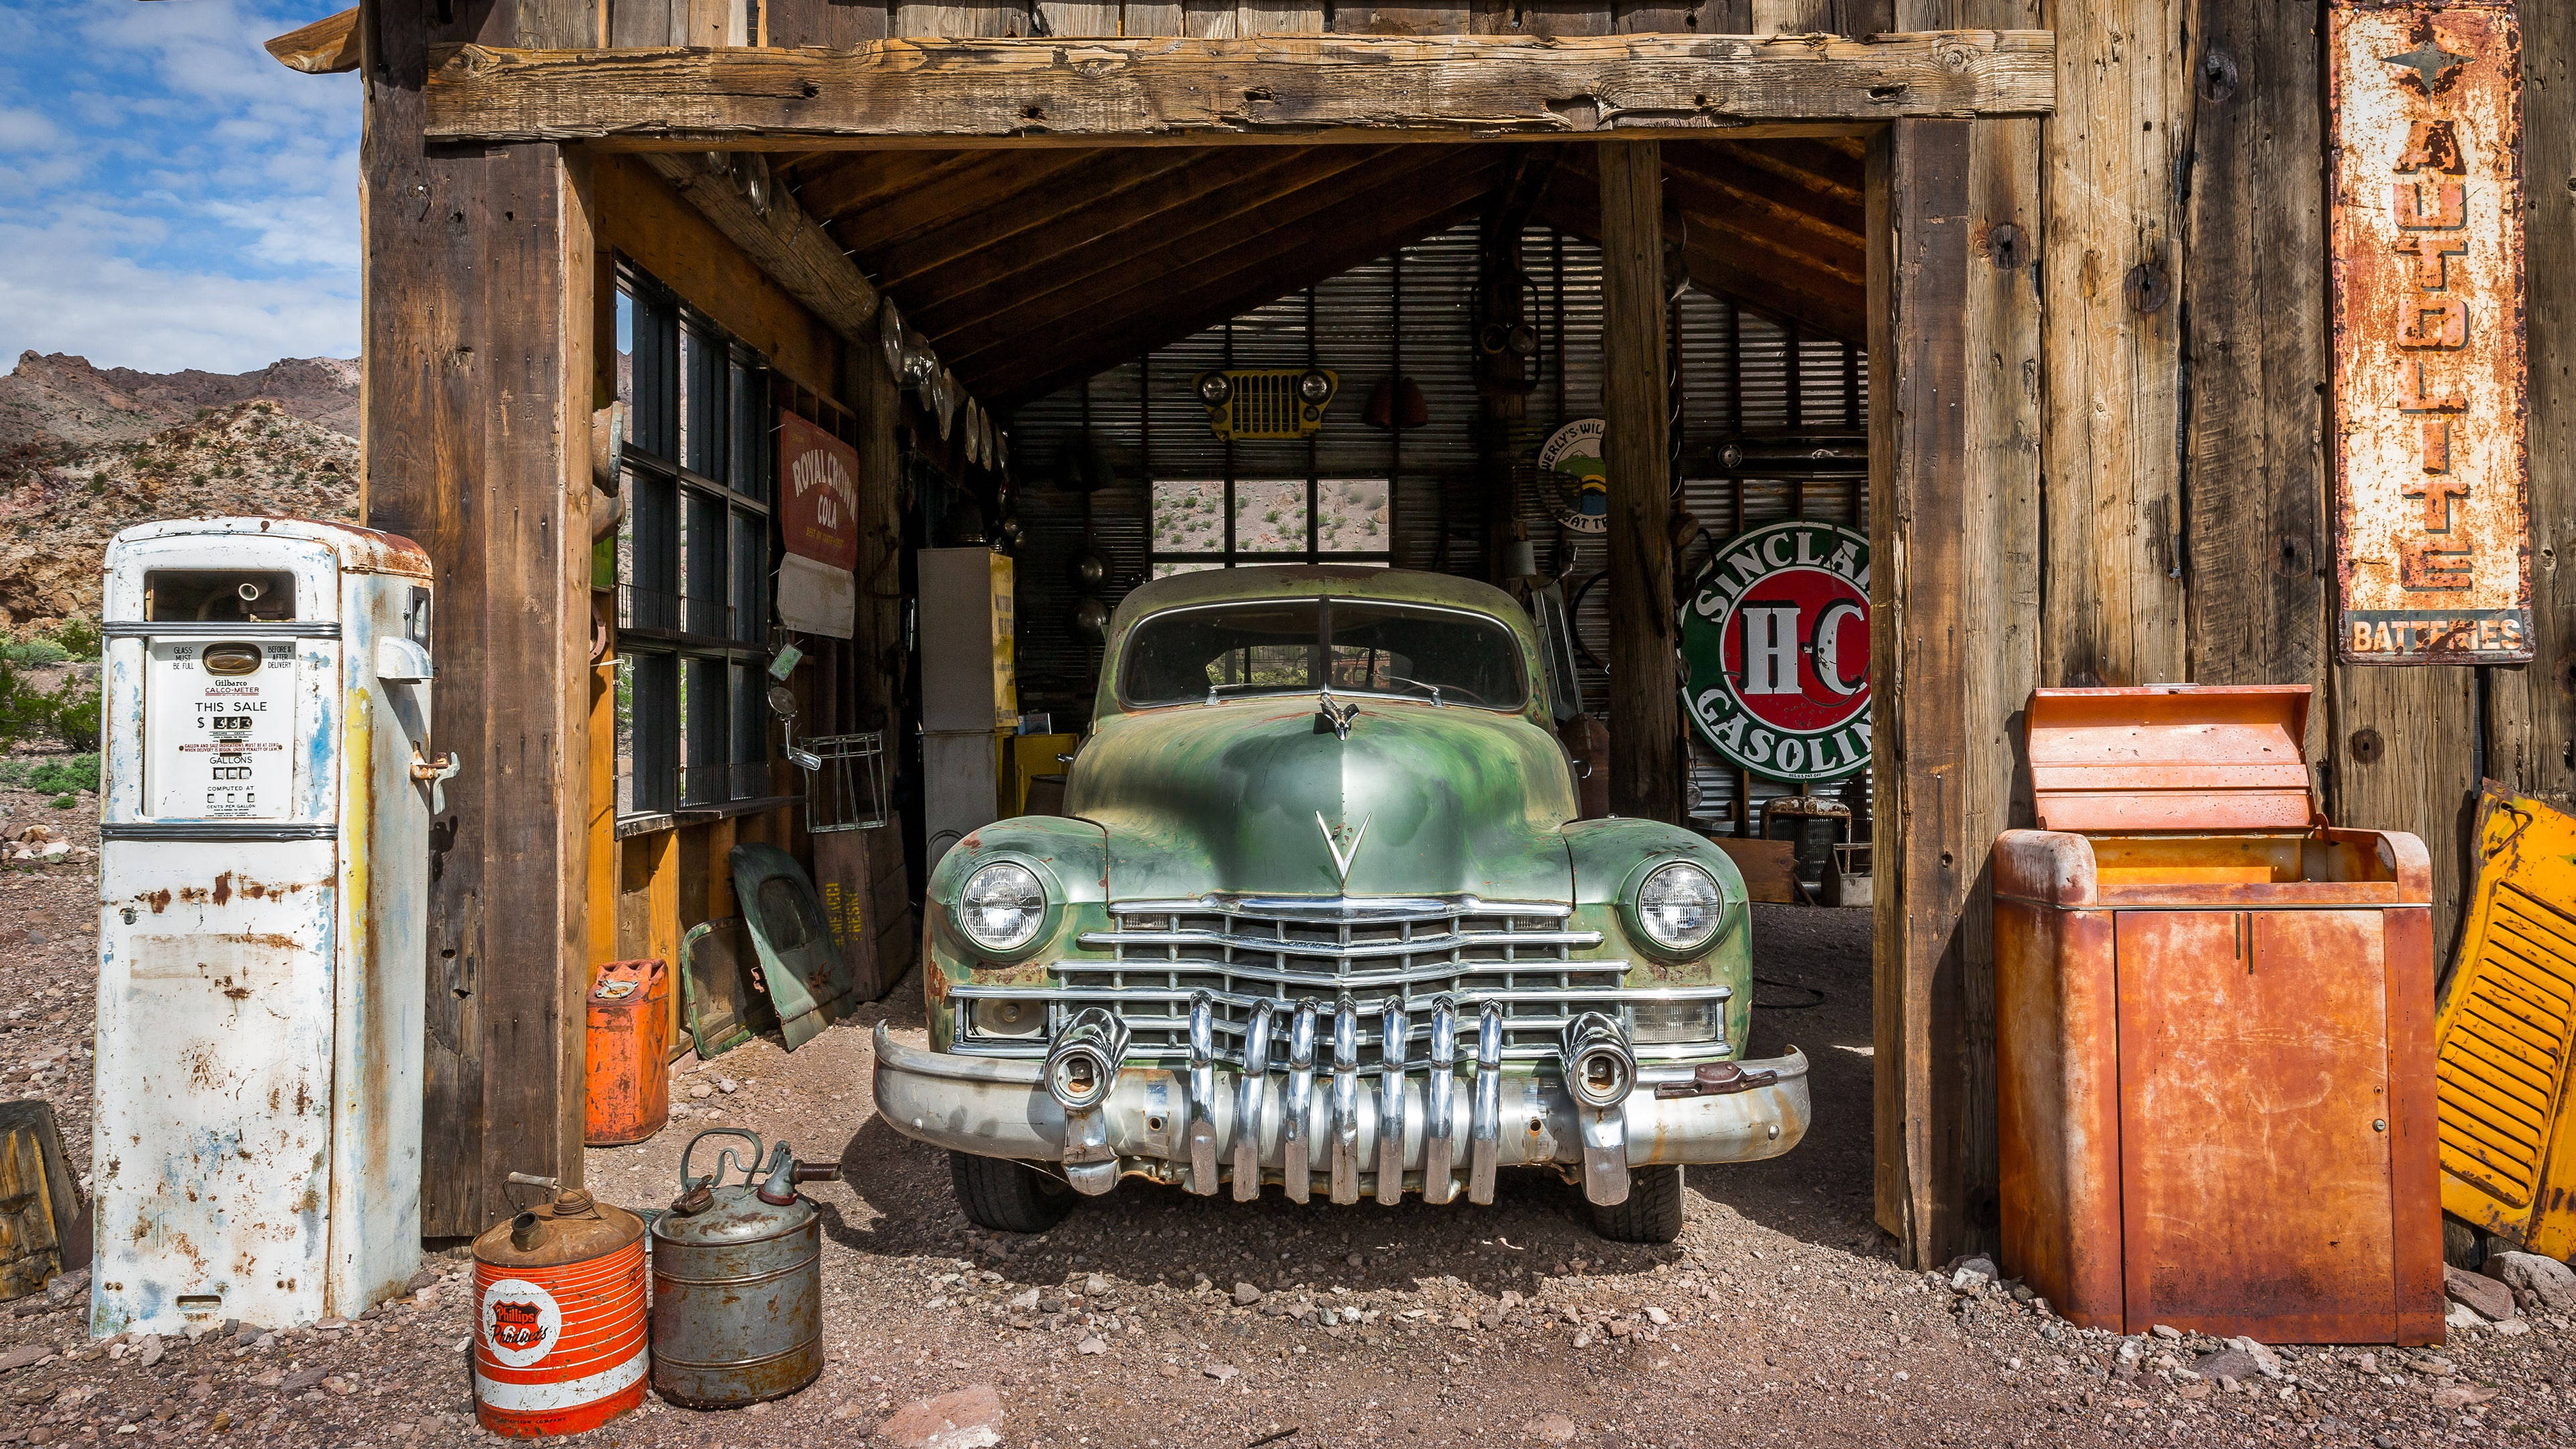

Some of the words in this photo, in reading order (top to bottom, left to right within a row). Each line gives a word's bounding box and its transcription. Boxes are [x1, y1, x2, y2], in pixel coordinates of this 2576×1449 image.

[2392, 119, 2473, 592] AUTOLITE
[792, 449, 826, 498] ROYAL
[827, 451, 857, 522] CROWN
[817, 494, 837, 531] COLA
[195, 702, 224, 712] THIS
[233, 702, 267, 711] SALE
[197, 717, 205, 729] $
[209, 756, 252, 764] GALLONS
[496, 1304, 535, 1326] Phillips
[490, 1324, 549, 1344] Products
